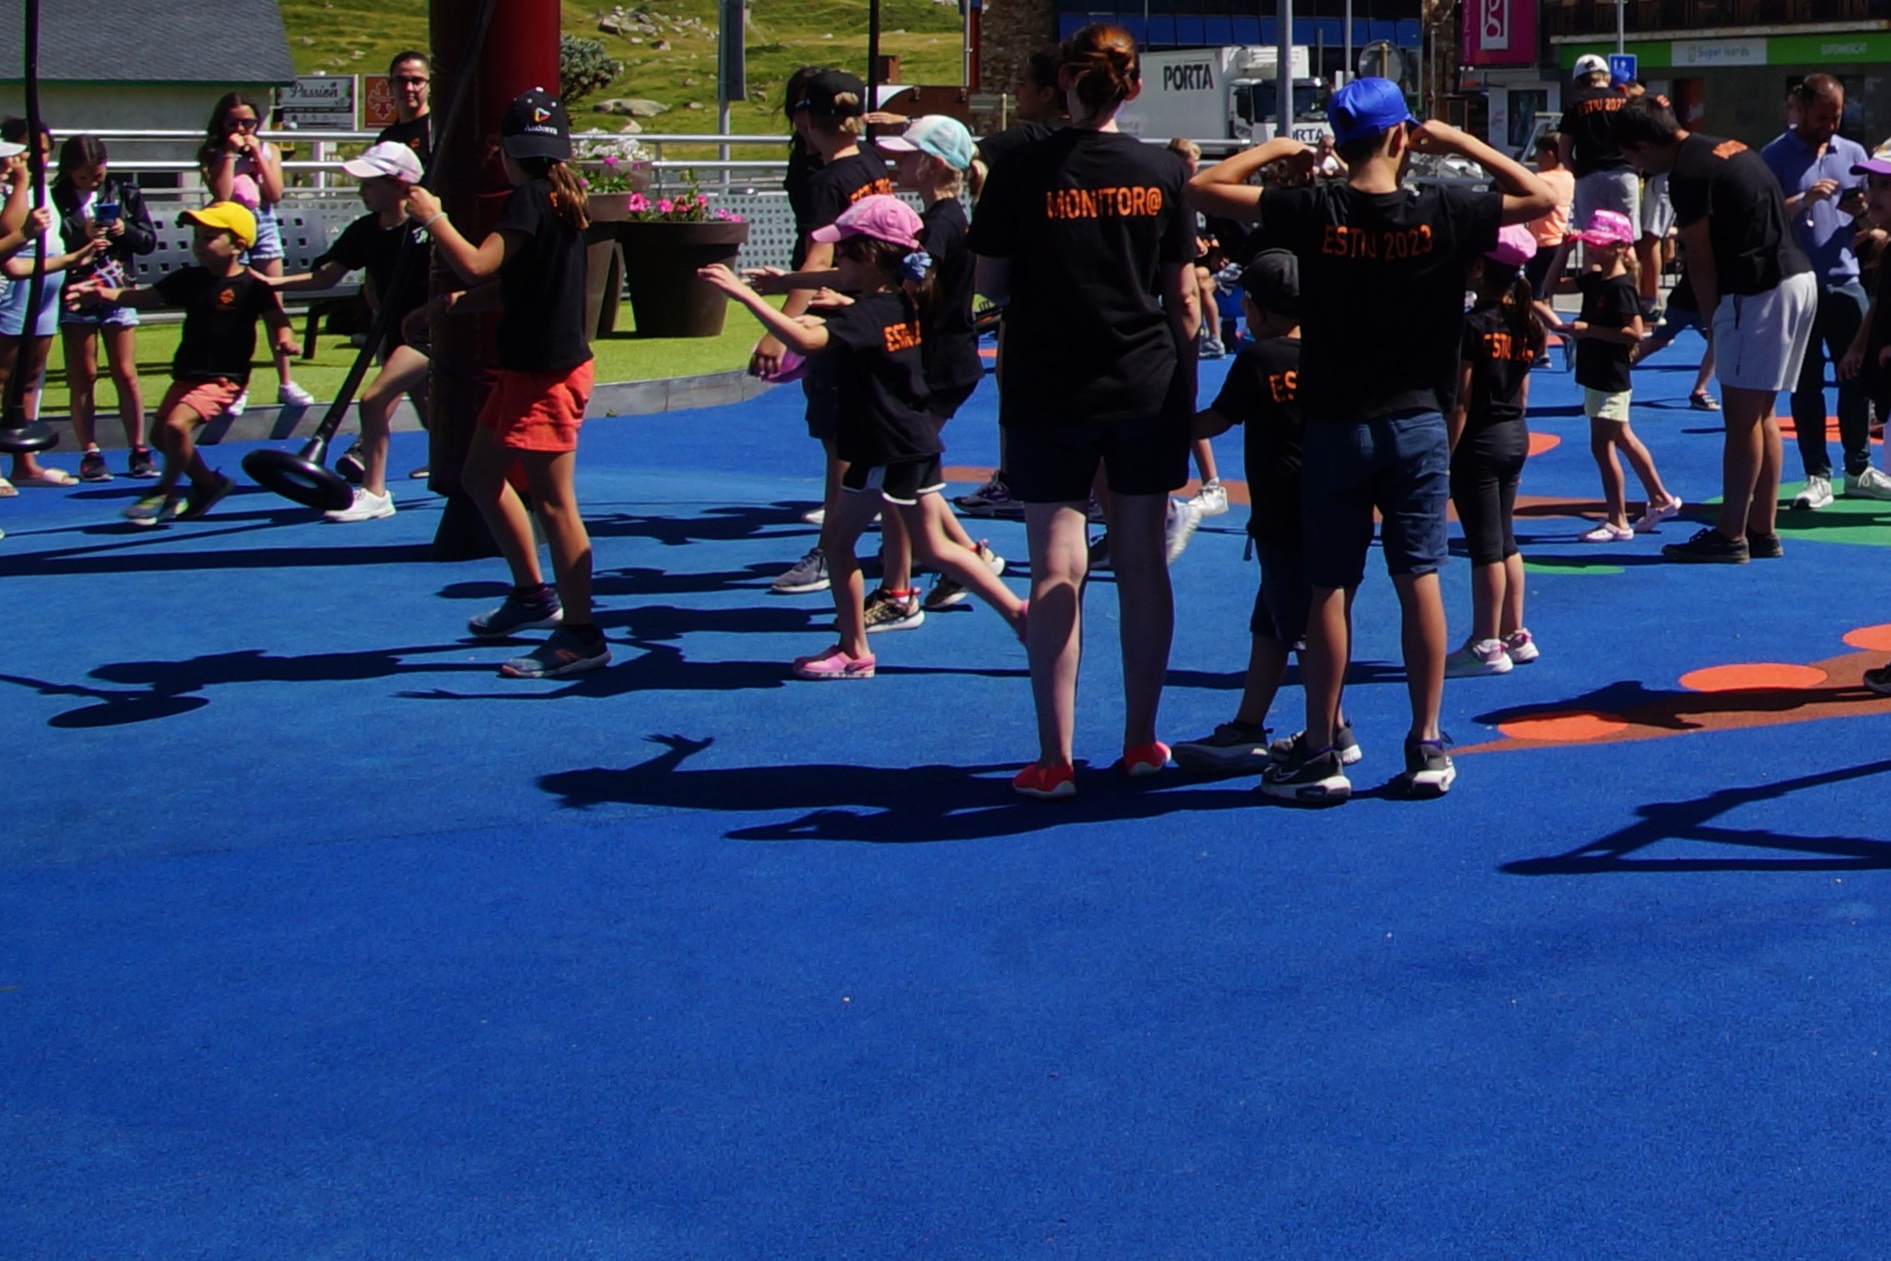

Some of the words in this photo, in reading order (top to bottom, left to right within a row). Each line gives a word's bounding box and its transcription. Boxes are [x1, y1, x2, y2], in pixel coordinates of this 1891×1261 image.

[1163, 63, 1214, 91] PORTA
[524, 124, 558, 136] Andorra
[1046, 186, 1163, 219] MONITOR@
[1383, 224, 1434, 260] 2023
